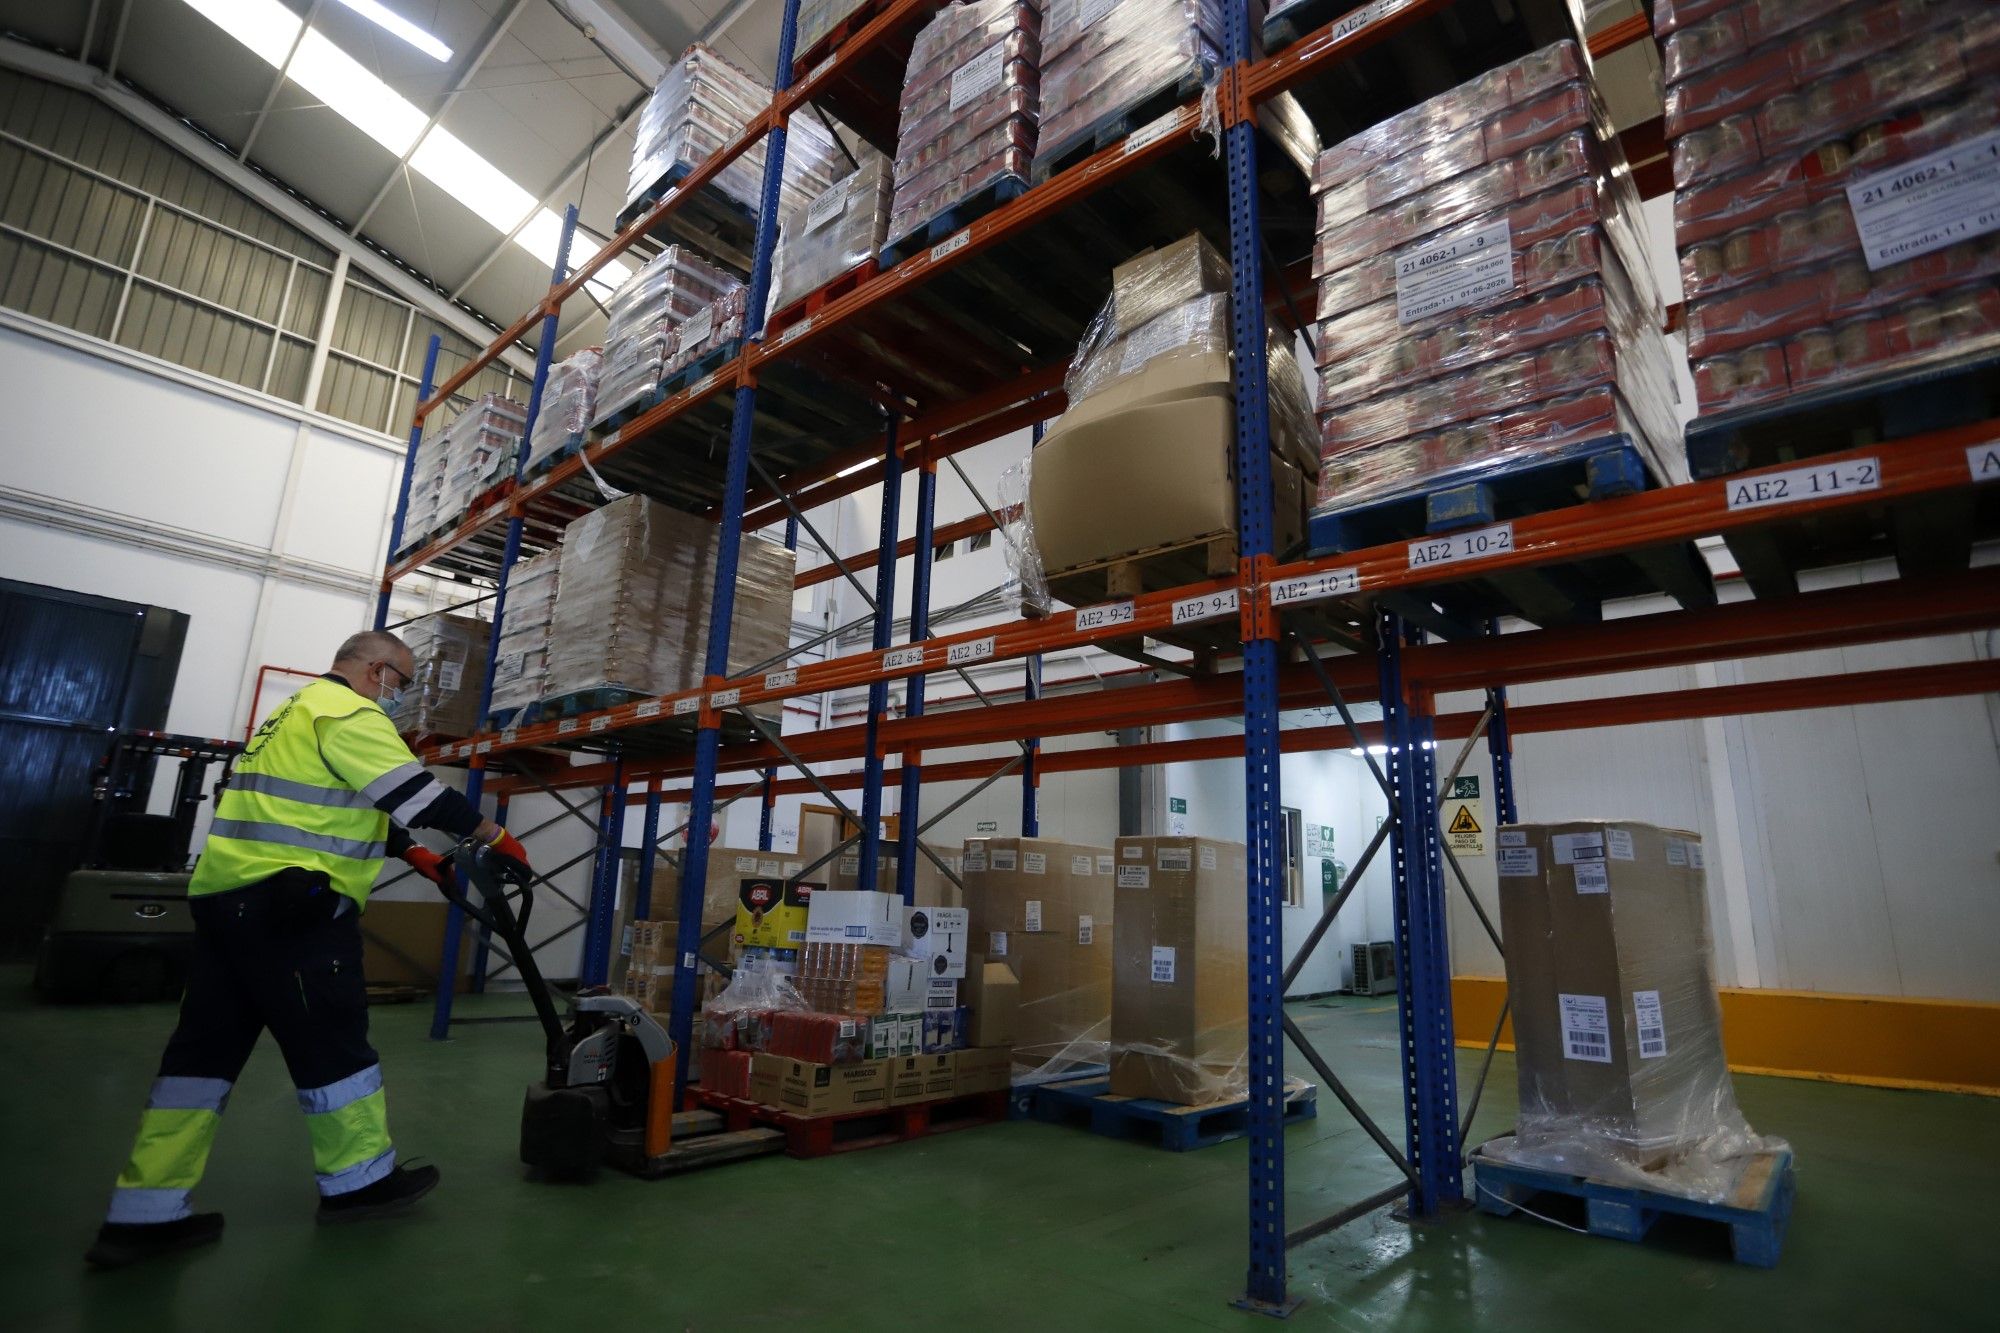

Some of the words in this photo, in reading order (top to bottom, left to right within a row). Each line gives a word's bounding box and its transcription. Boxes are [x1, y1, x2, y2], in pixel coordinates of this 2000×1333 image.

[1337, 12, 1368, 38] AE2
[1861, 186, 1885, 204] 21
[1891, 159, 1957, 193] 4062-1
[1402, 261, 1416, 273] 21
[1419, 246, 1457, 266] 4062-1
[1405, 294, 1455, 318] Entrada-1-1
[1460, 277, 1507, 298] 01-06-2026
[1733, 478, 1790, 506] AE2
[1808, 465, 1875, 493] 11-2
[1413, 542, 1453, 565] AE2
[1465, 531, 1510, 555] 10-2
[1275, 581, 1308, 601] AE2
[1317, 573, 1357, 593] 10-1
[1078, 610, 1103, 627] AE2
[1110, 606, 1132, 622] 9-2
[1176, 601, 1205, 620] AE2
[1212, 594, 1236, 612] 9-1
[884, 654, 903, 668] AE2
[907, 650, 923, 664] 8-2
[950, 646, 970, 661] AE2
[975, 641, 992, 656] 8-1
[766, 676, 782, 688] AE2
[843, 1068, 877, 1080] MARISCOS
